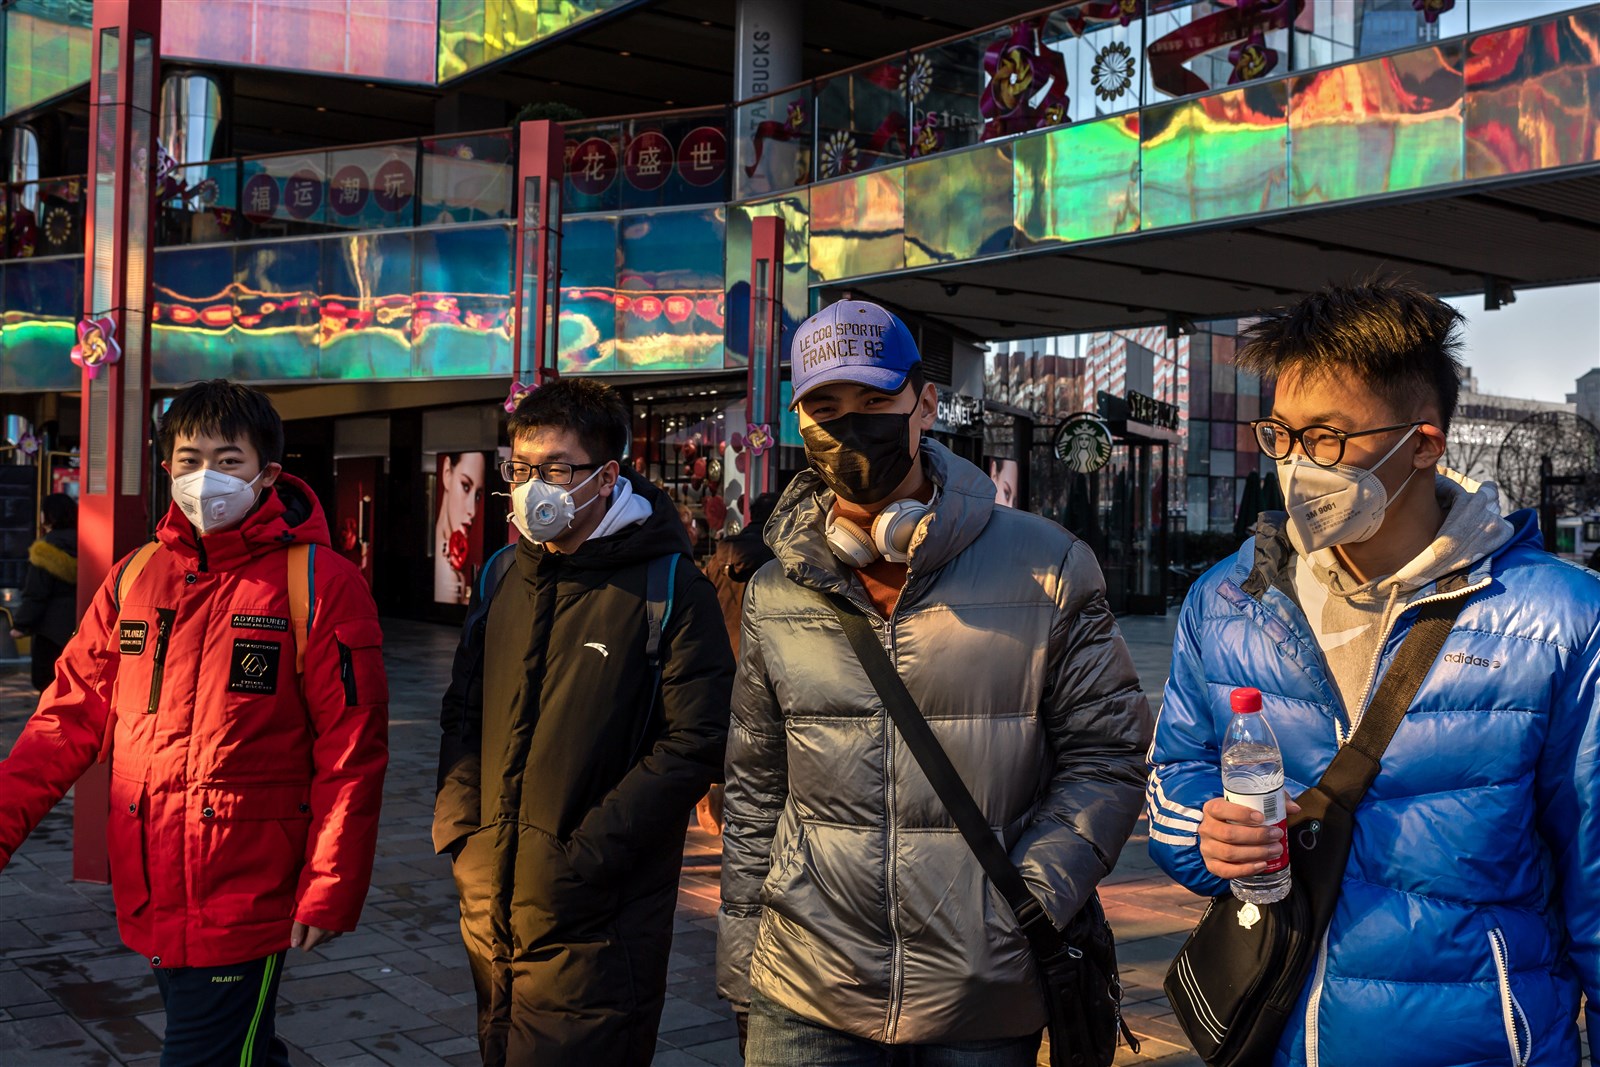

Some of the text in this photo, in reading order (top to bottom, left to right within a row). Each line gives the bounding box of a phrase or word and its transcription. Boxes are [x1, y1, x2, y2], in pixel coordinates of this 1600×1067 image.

[750, 31, 770, 139] TABUCKS
[251, 172, 404, 212] 福运潮玩
[800, 323, 886, 352] LE COQ SPORTIF
[802, 339, 885, 372] FRANCE 82
[937, 401, 972, 425] CHANEL
[1305, 510, 1318, 521] 3M
[1318, 502, 1337, 515] 9001
[233, 615, 287, 626] ADVENTURER
[1444, 652, 1490, 668] adidas
